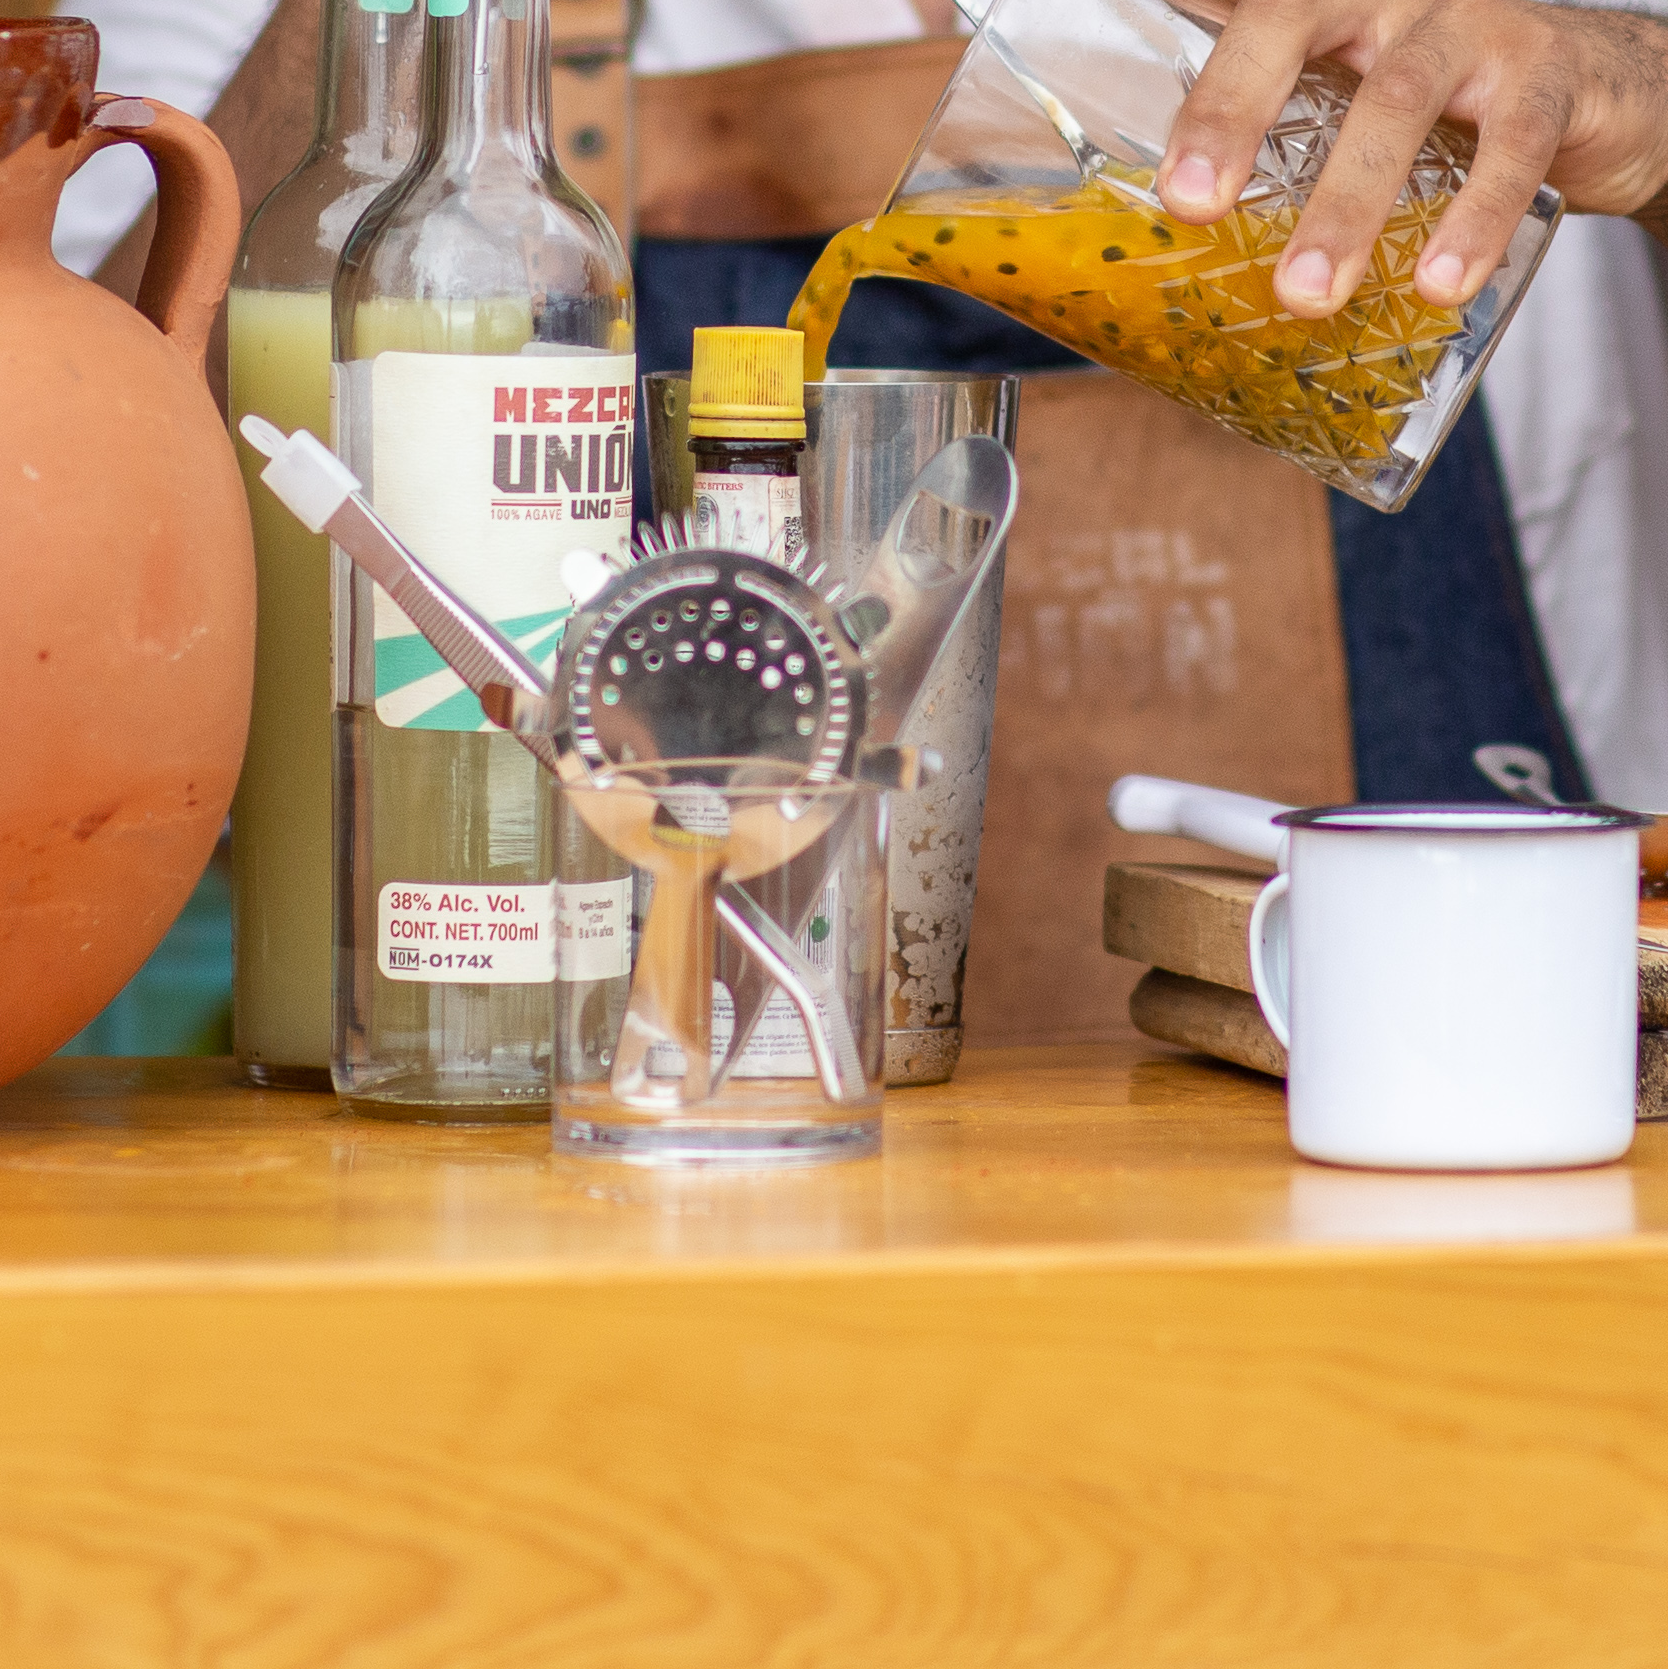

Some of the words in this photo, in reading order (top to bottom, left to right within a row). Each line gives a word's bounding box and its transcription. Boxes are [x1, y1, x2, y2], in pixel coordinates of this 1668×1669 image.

[494, 385, 634, 423] MEZCA
[708, 482, 744, 491] BITTERS
[491, 508, 520, 520] 100%
[525, 508, 562, 520] AGAVE
[571, 499, 611, 520] UNO
[390, 892, 432, 911] 38%
[438, 893, 479, 913] Alc.
[487, 894, 525, 913] Vol.
[390, 920, 440, 940] CONT.
[446, 922, 484, 941] NET.
[488, 922, 539, 941] 700ml
